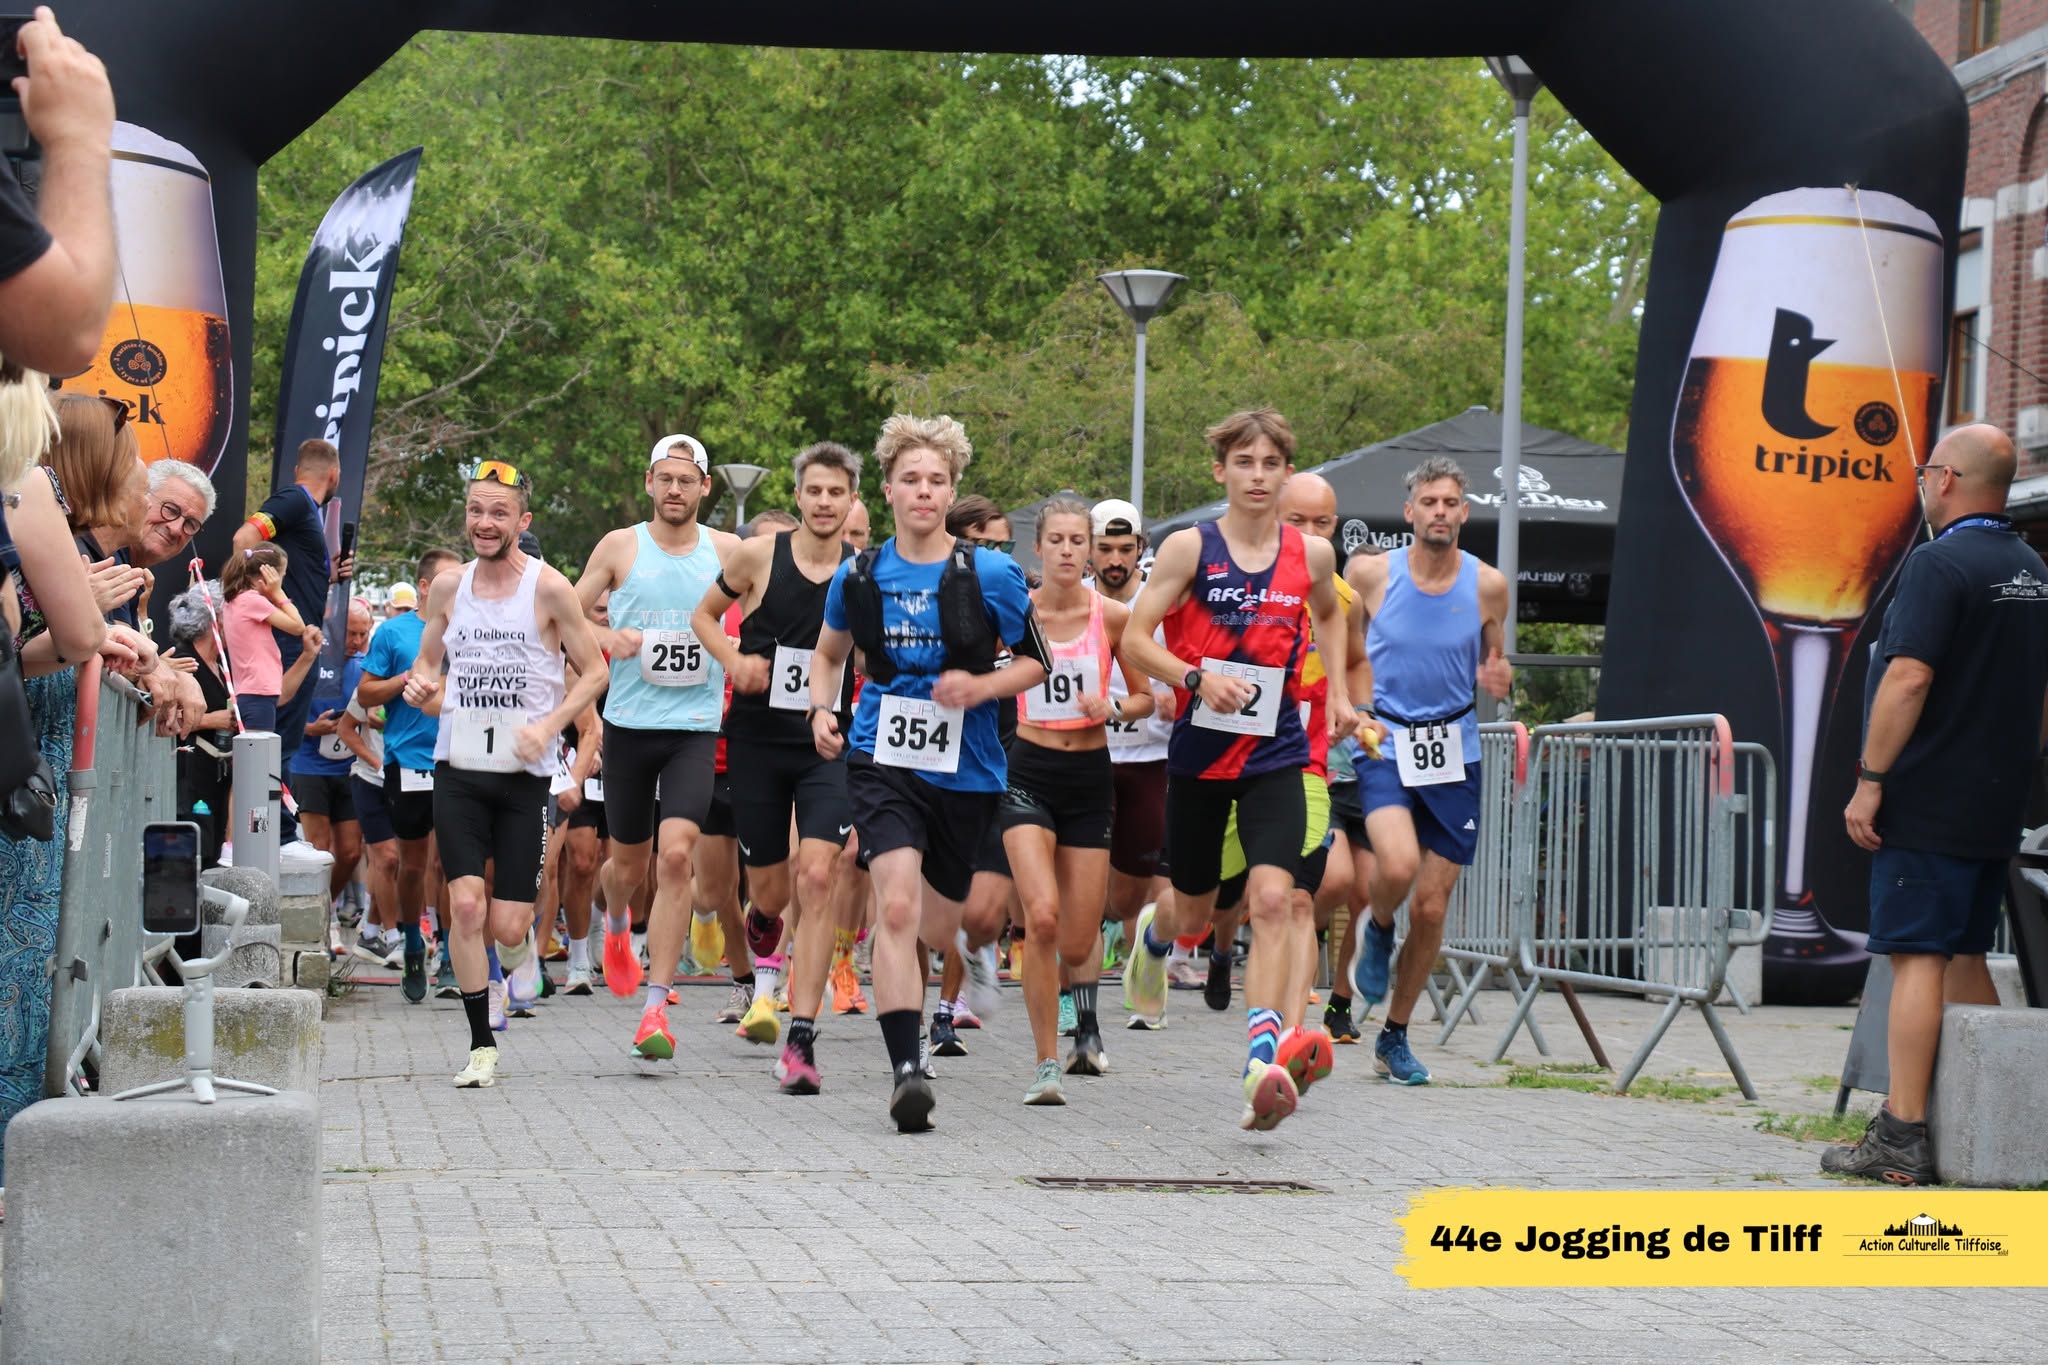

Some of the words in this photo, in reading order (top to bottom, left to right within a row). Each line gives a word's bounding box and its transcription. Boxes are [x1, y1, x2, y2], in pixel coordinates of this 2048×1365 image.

[1755, 444, 1894, 483] tripick
[1370, 531, 1416, 549] Val-D
[1207, 587, 1246, 602] RFC
[1259, 588, 1301, 607] Liège
[641, 609, 692, 625] VALEN
[474, 628, 525, 643] Delbecq
[651, 643, 701, 672] 255
[457, 676, 527, 690] DUFAYS
[1044, 672, 1085, 704] 191
[484, 726, 495, 754] 1
[887, 715, 950, 753] 354
[1413, 741, 1446, 771] 98
